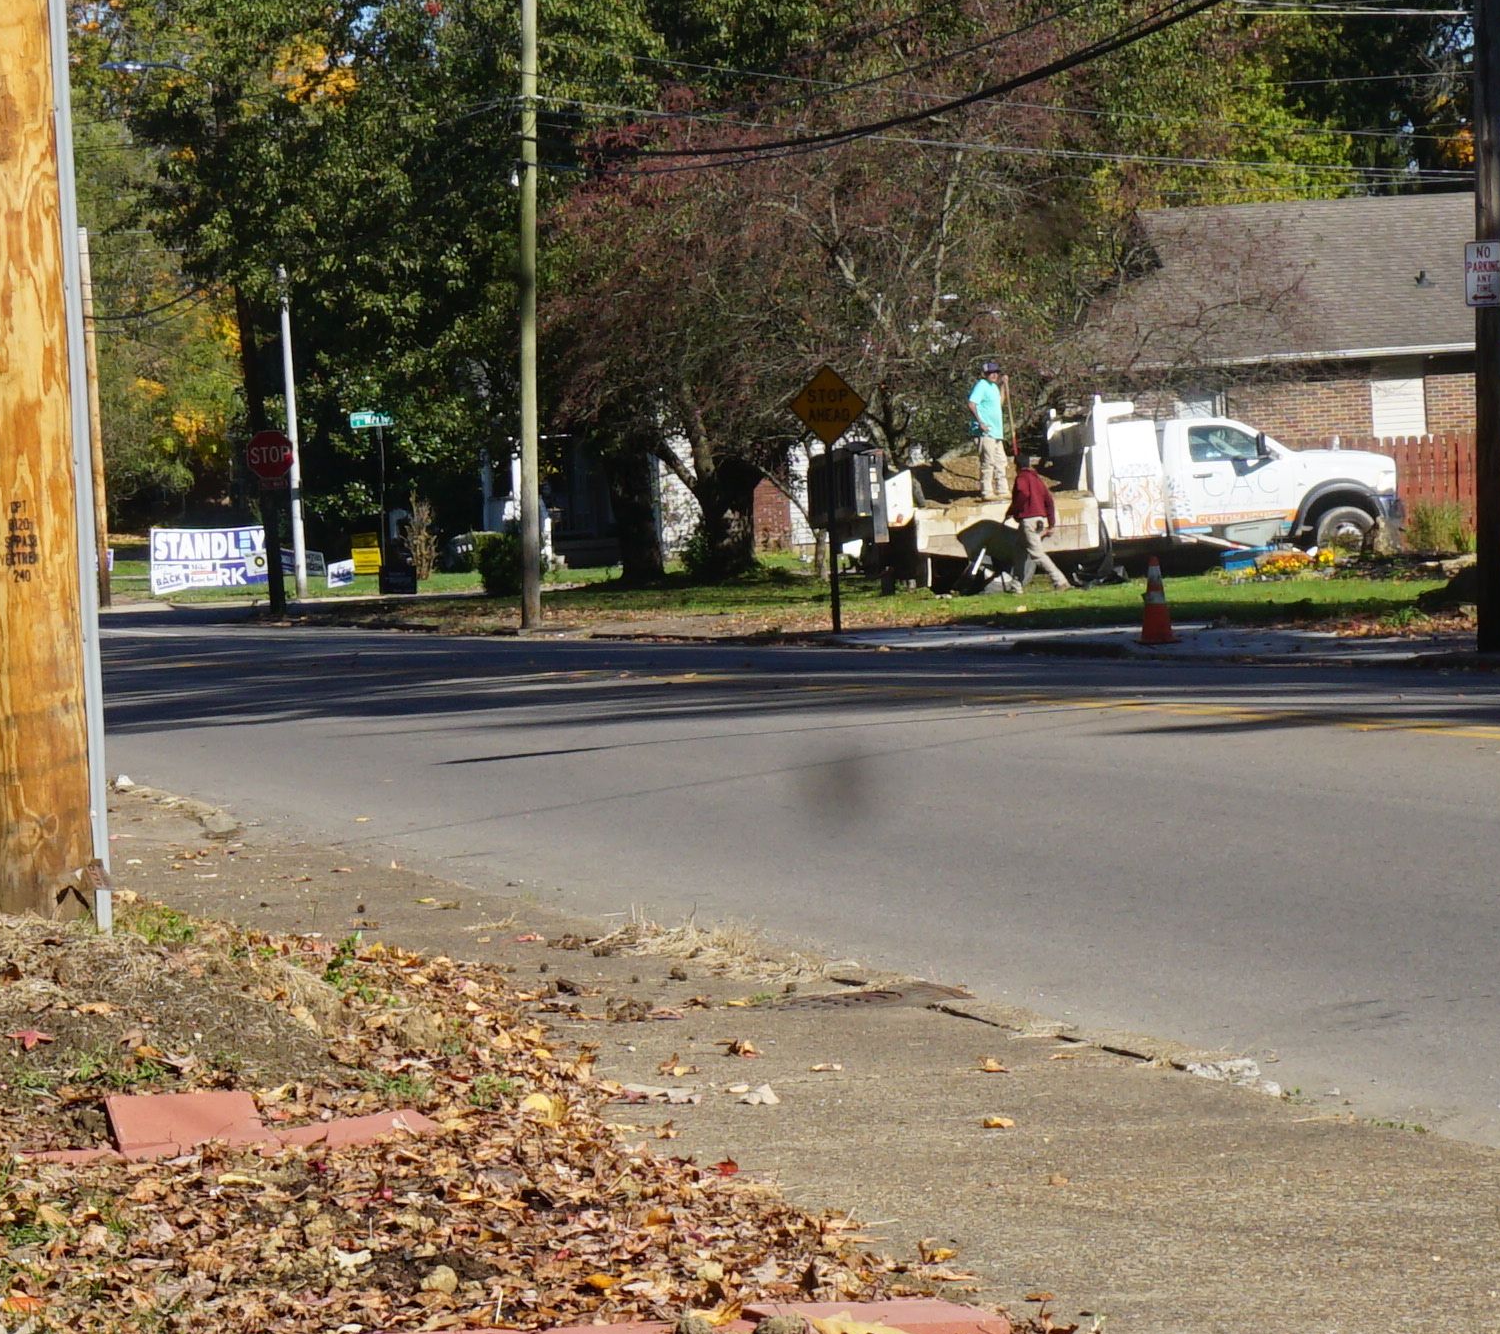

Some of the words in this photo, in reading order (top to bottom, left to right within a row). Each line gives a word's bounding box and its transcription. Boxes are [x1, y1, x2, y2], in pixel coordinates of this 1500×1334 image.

[1476, 245, 1490, 258] NO
[1465, 260, 1500, 272] PARKING
[1477, 274, 1491, 283] ANY
[1476, 283, 1491, 292] TIME
[807, 388, 849, 403] STOP
[807, 408, 850, 422] AHEAD
[250, 445, 291, 464] STOP
[154, 529, 266, 560] STANDLEY
[13, 569, 31, 583] 240
